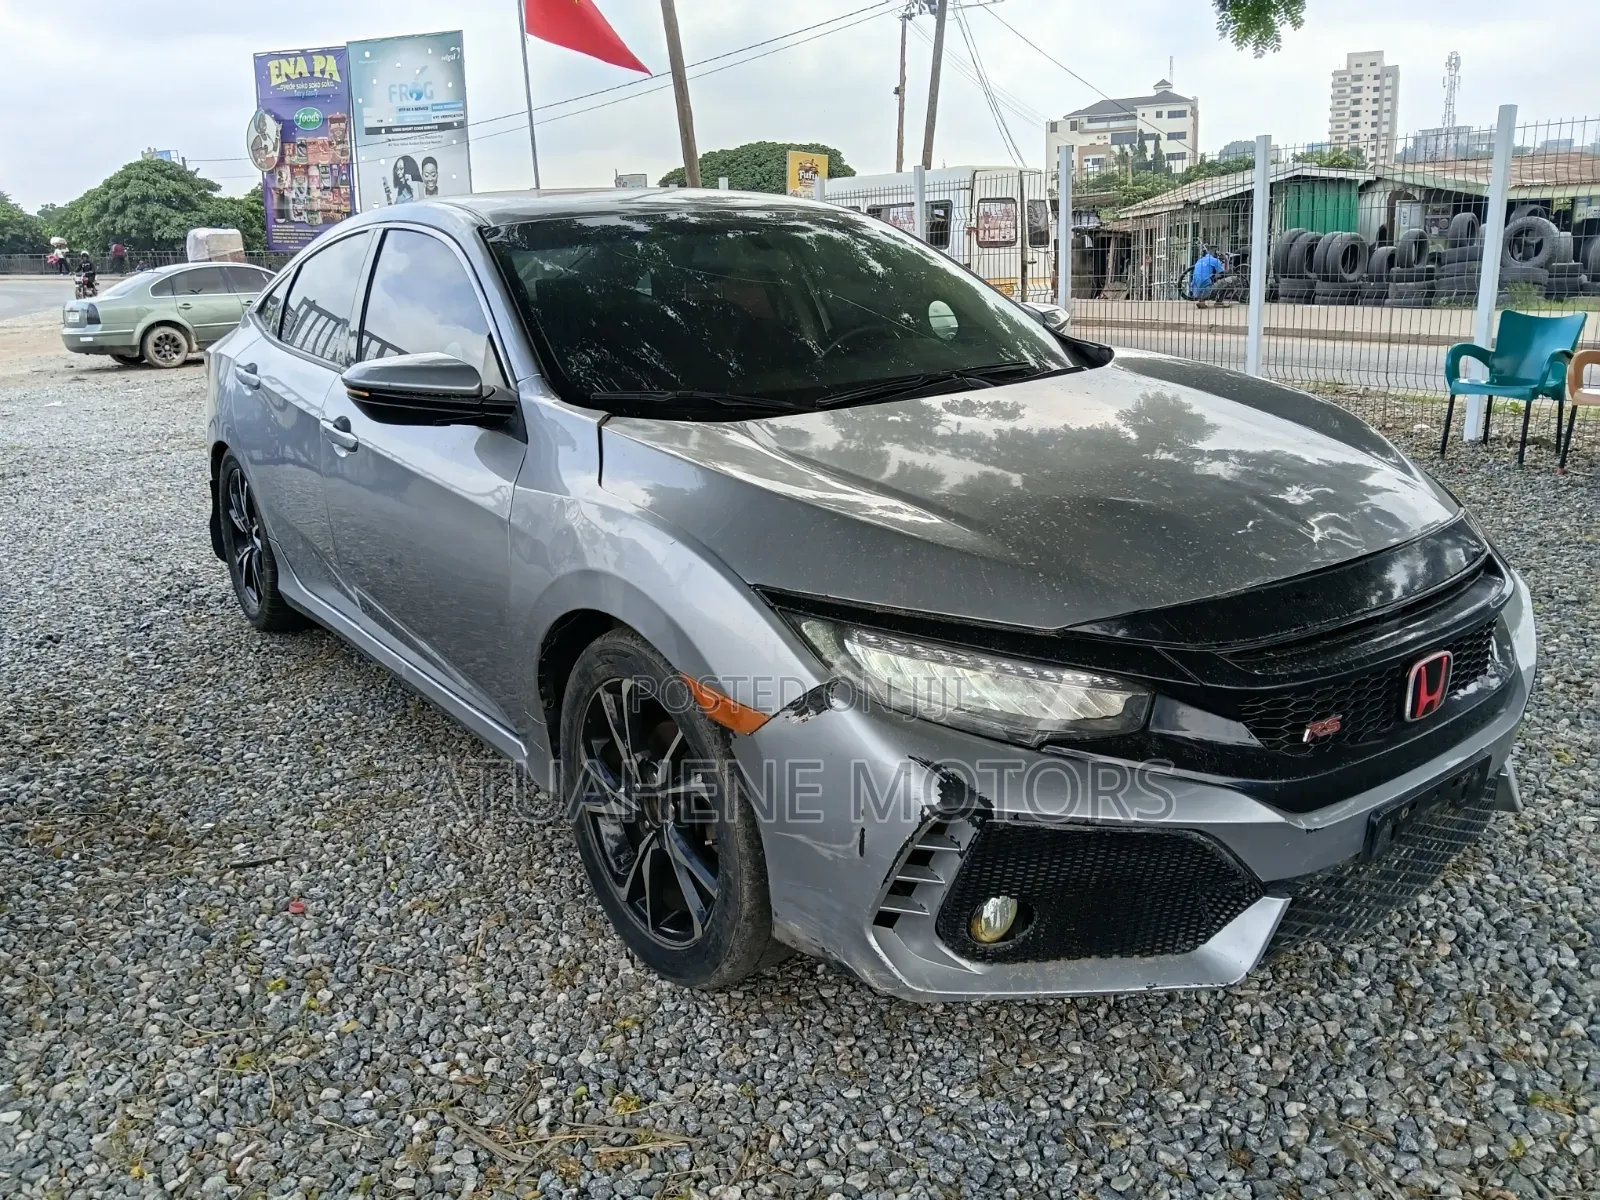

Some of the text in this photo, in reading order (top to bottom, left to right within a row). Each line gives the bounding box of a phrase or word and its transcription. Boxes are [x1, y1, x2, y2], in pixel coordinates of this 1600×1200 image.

[268, 55, 342, 87] ENA PA
[388, 80, 434, 103] FROG
[298, 111, 320, 126] foods
[1304, 714, 1343, 742] RS
